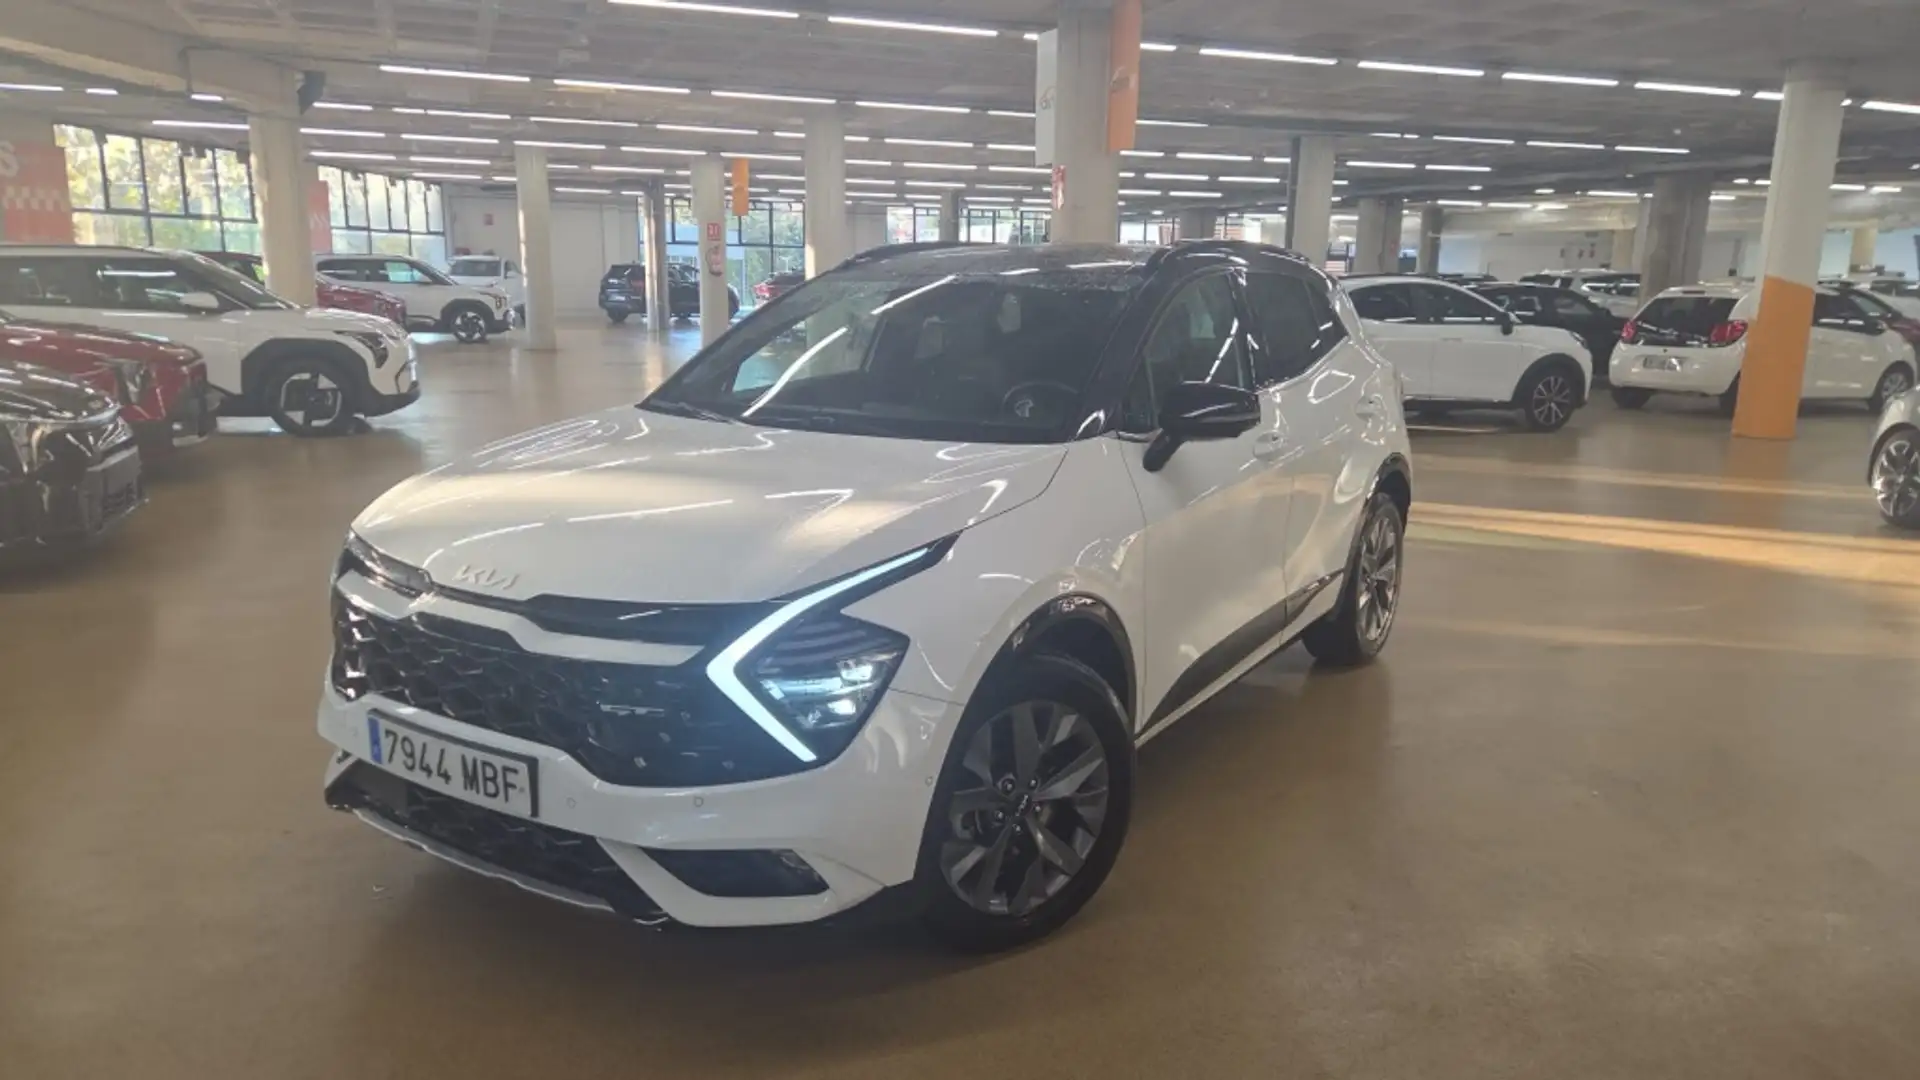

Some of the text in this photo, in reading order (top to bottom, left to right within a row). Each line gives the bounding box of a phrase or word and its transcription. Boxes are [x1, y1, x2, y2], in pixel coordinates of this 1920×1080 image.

[454, 563, 520, 590] KIA
[384, 728, 519, 802] 7944 MBF
